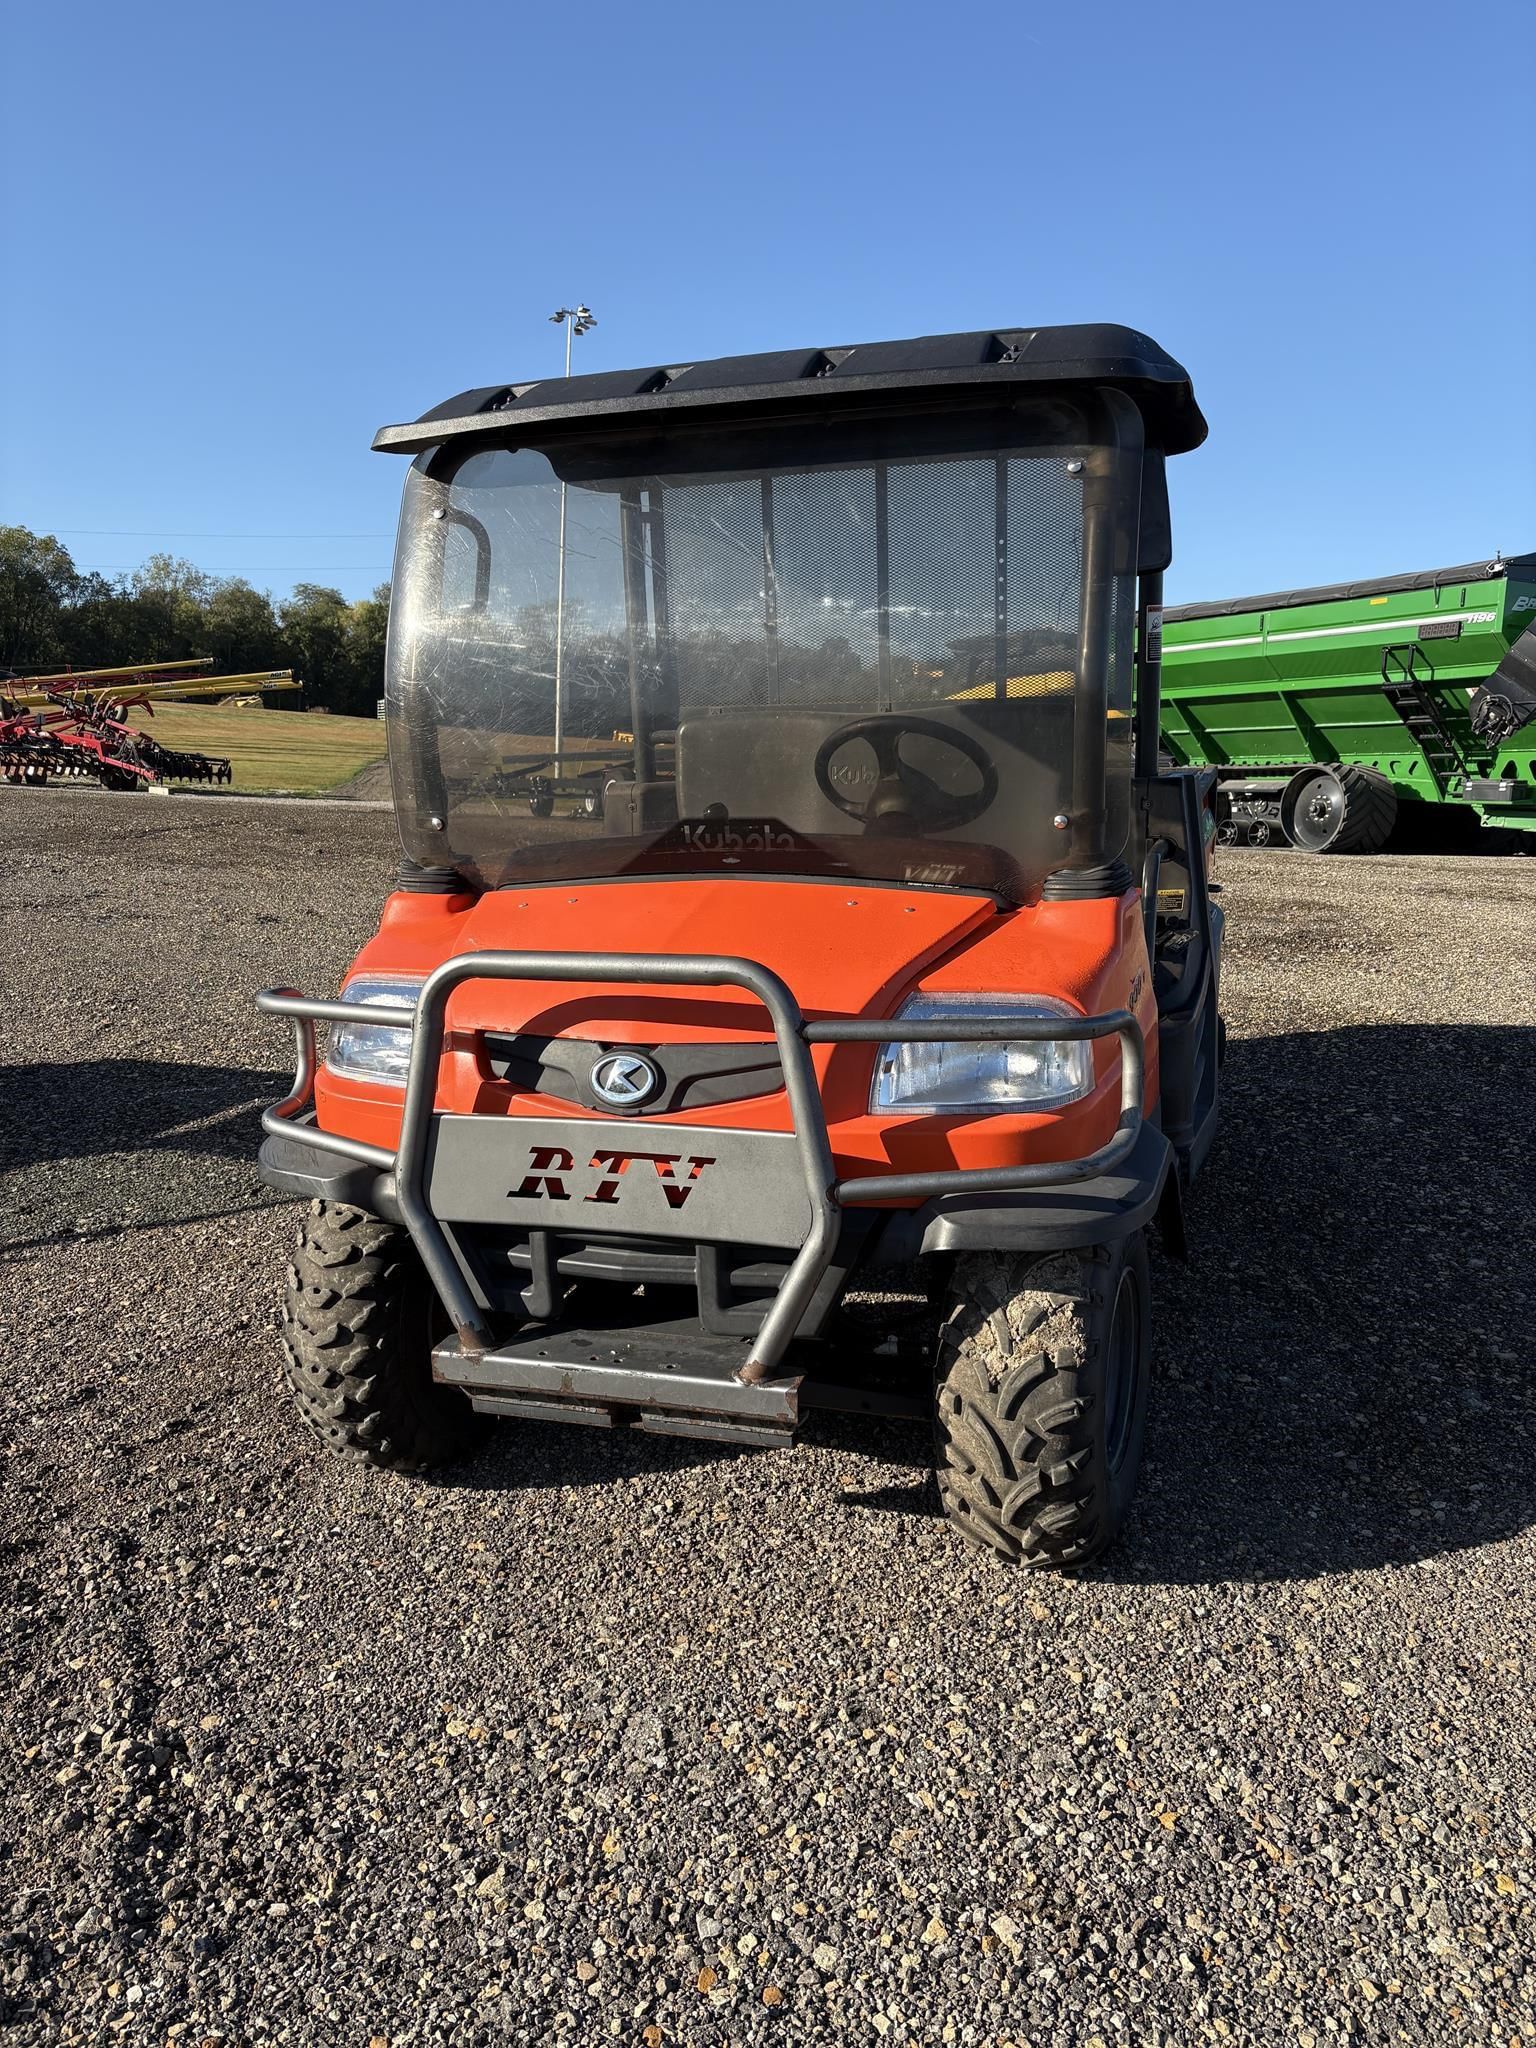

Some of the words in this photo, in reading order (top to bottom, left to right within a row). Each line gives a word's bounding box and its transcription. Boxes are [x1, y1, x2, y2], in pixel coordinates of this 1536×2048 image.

[1467, 612, 1497, 624] 1196
[682, 825, 795, 852] Kubota
[506, 1146, 717, 1209] RTV
